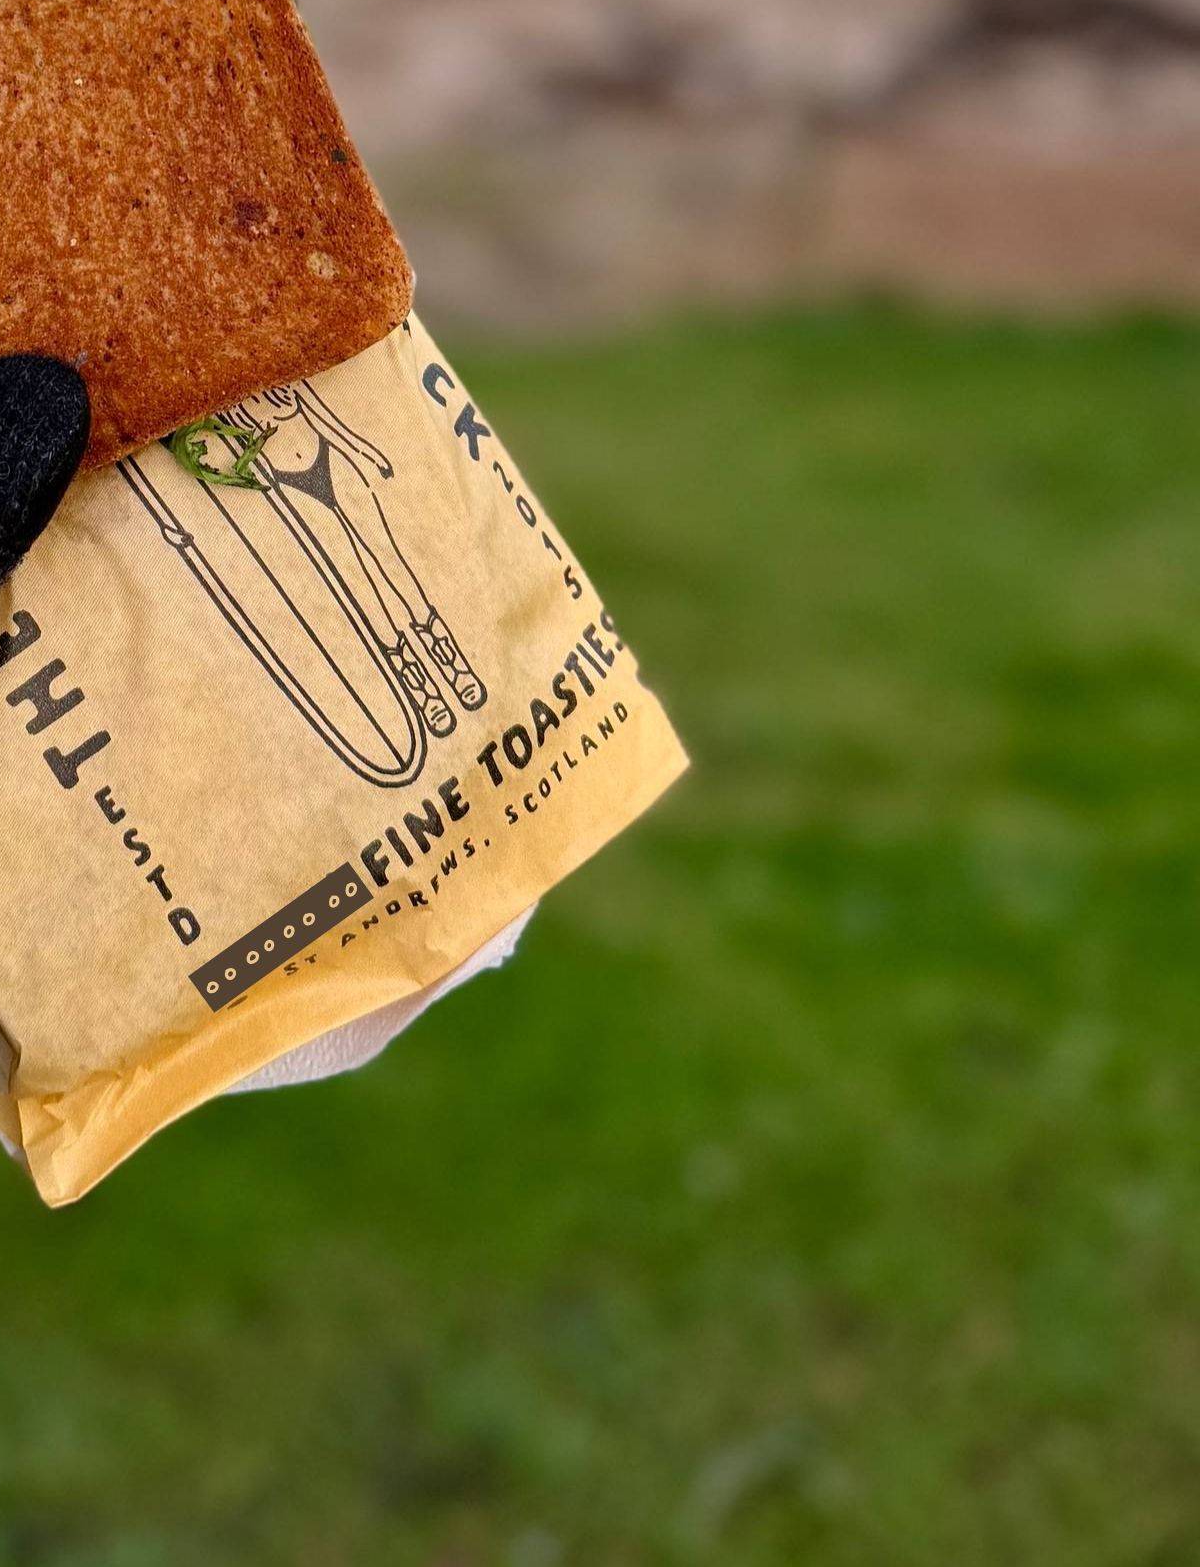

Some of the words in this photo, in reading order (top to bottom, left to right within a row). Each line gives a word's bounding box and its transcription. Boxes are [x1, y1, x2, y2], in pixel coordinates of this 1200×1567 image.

[492, 460, 582, 600] 2015
[283, 954, 318, 976] ST
[504, 701, 629, 826] SCOTLAND
[360, 775, 470, 888] FINE
